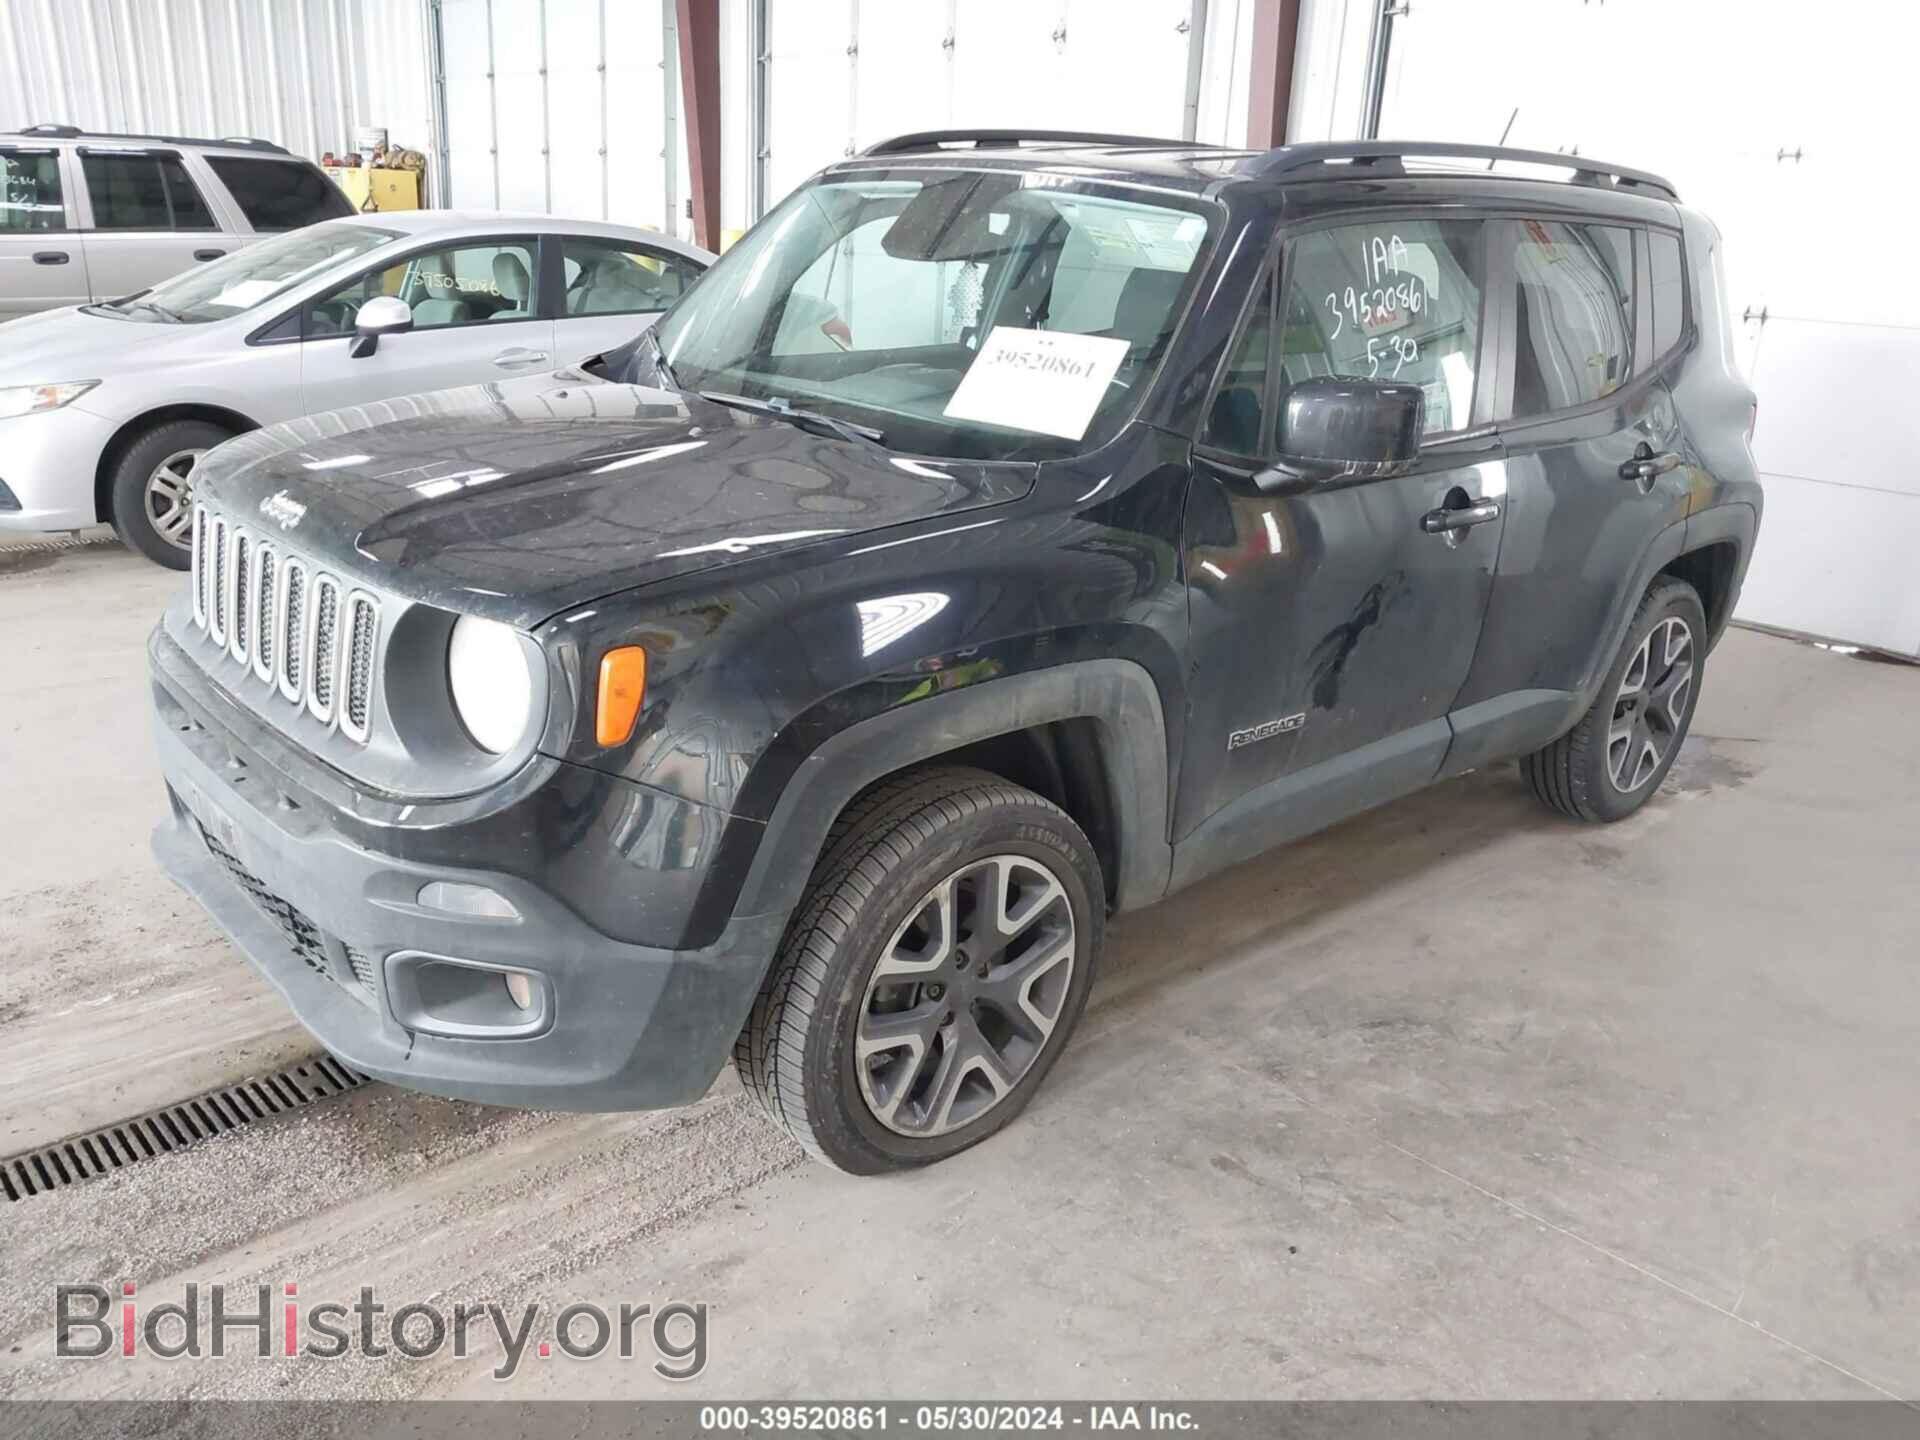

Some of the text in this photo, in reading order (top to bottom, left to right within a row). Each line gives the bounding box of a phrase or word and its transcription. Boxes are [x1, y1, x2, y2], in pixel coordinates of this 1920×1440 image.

[1362, 234, 1408, 287] IAA
[1325, 277, 1428, 340] 39520861
[986, 348, 1097, 379] 39520861
[1367, 335, 1418, 378] 5-30
[1227, 712, 1305, 750] RENEGADE
